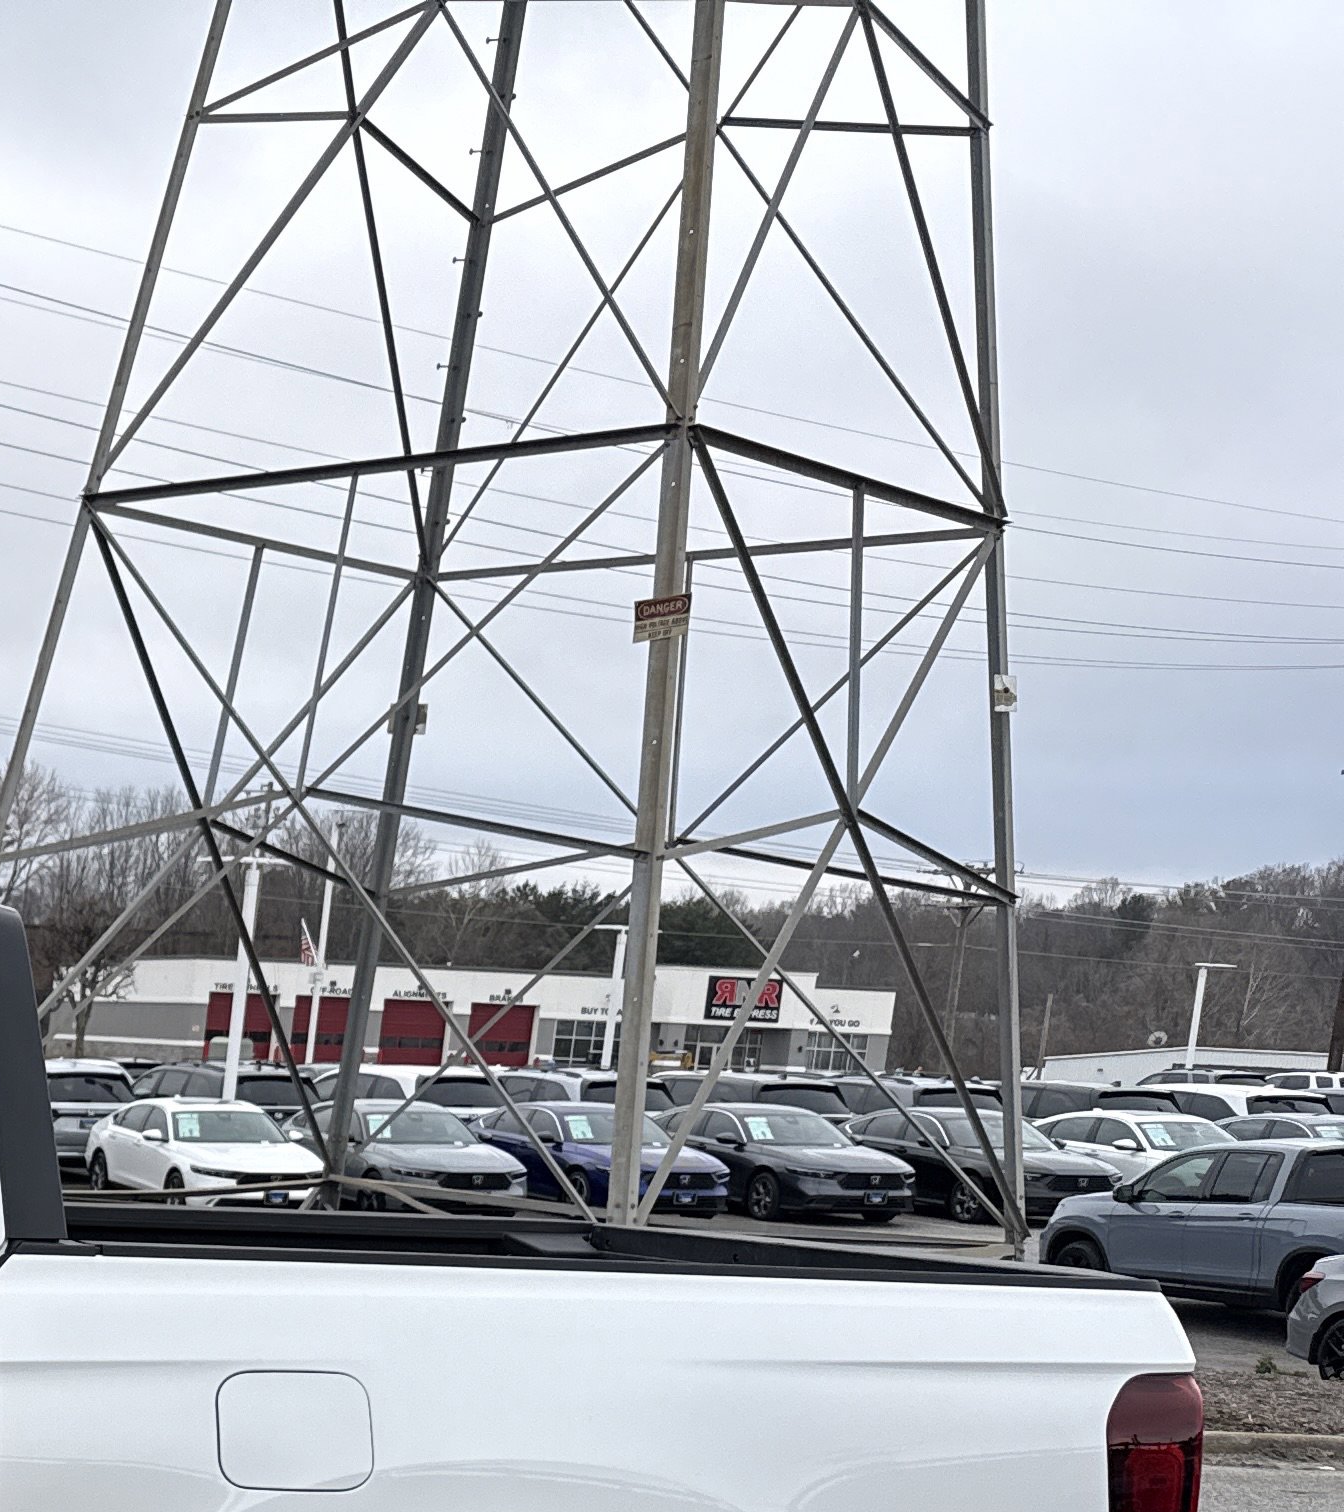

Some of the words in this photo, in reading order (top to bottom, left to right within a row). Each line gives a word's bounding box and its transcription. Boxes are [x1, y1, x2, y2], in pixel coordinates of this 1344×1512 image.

[643, 600, 683, 616] DANGER
[581, 1007, 598, 1016] BUY
[710, 1007, 732, 1018] TIRE
[733, 1008, 778, 1020] ERESS
[847, 1019, 861, 1028] GO
